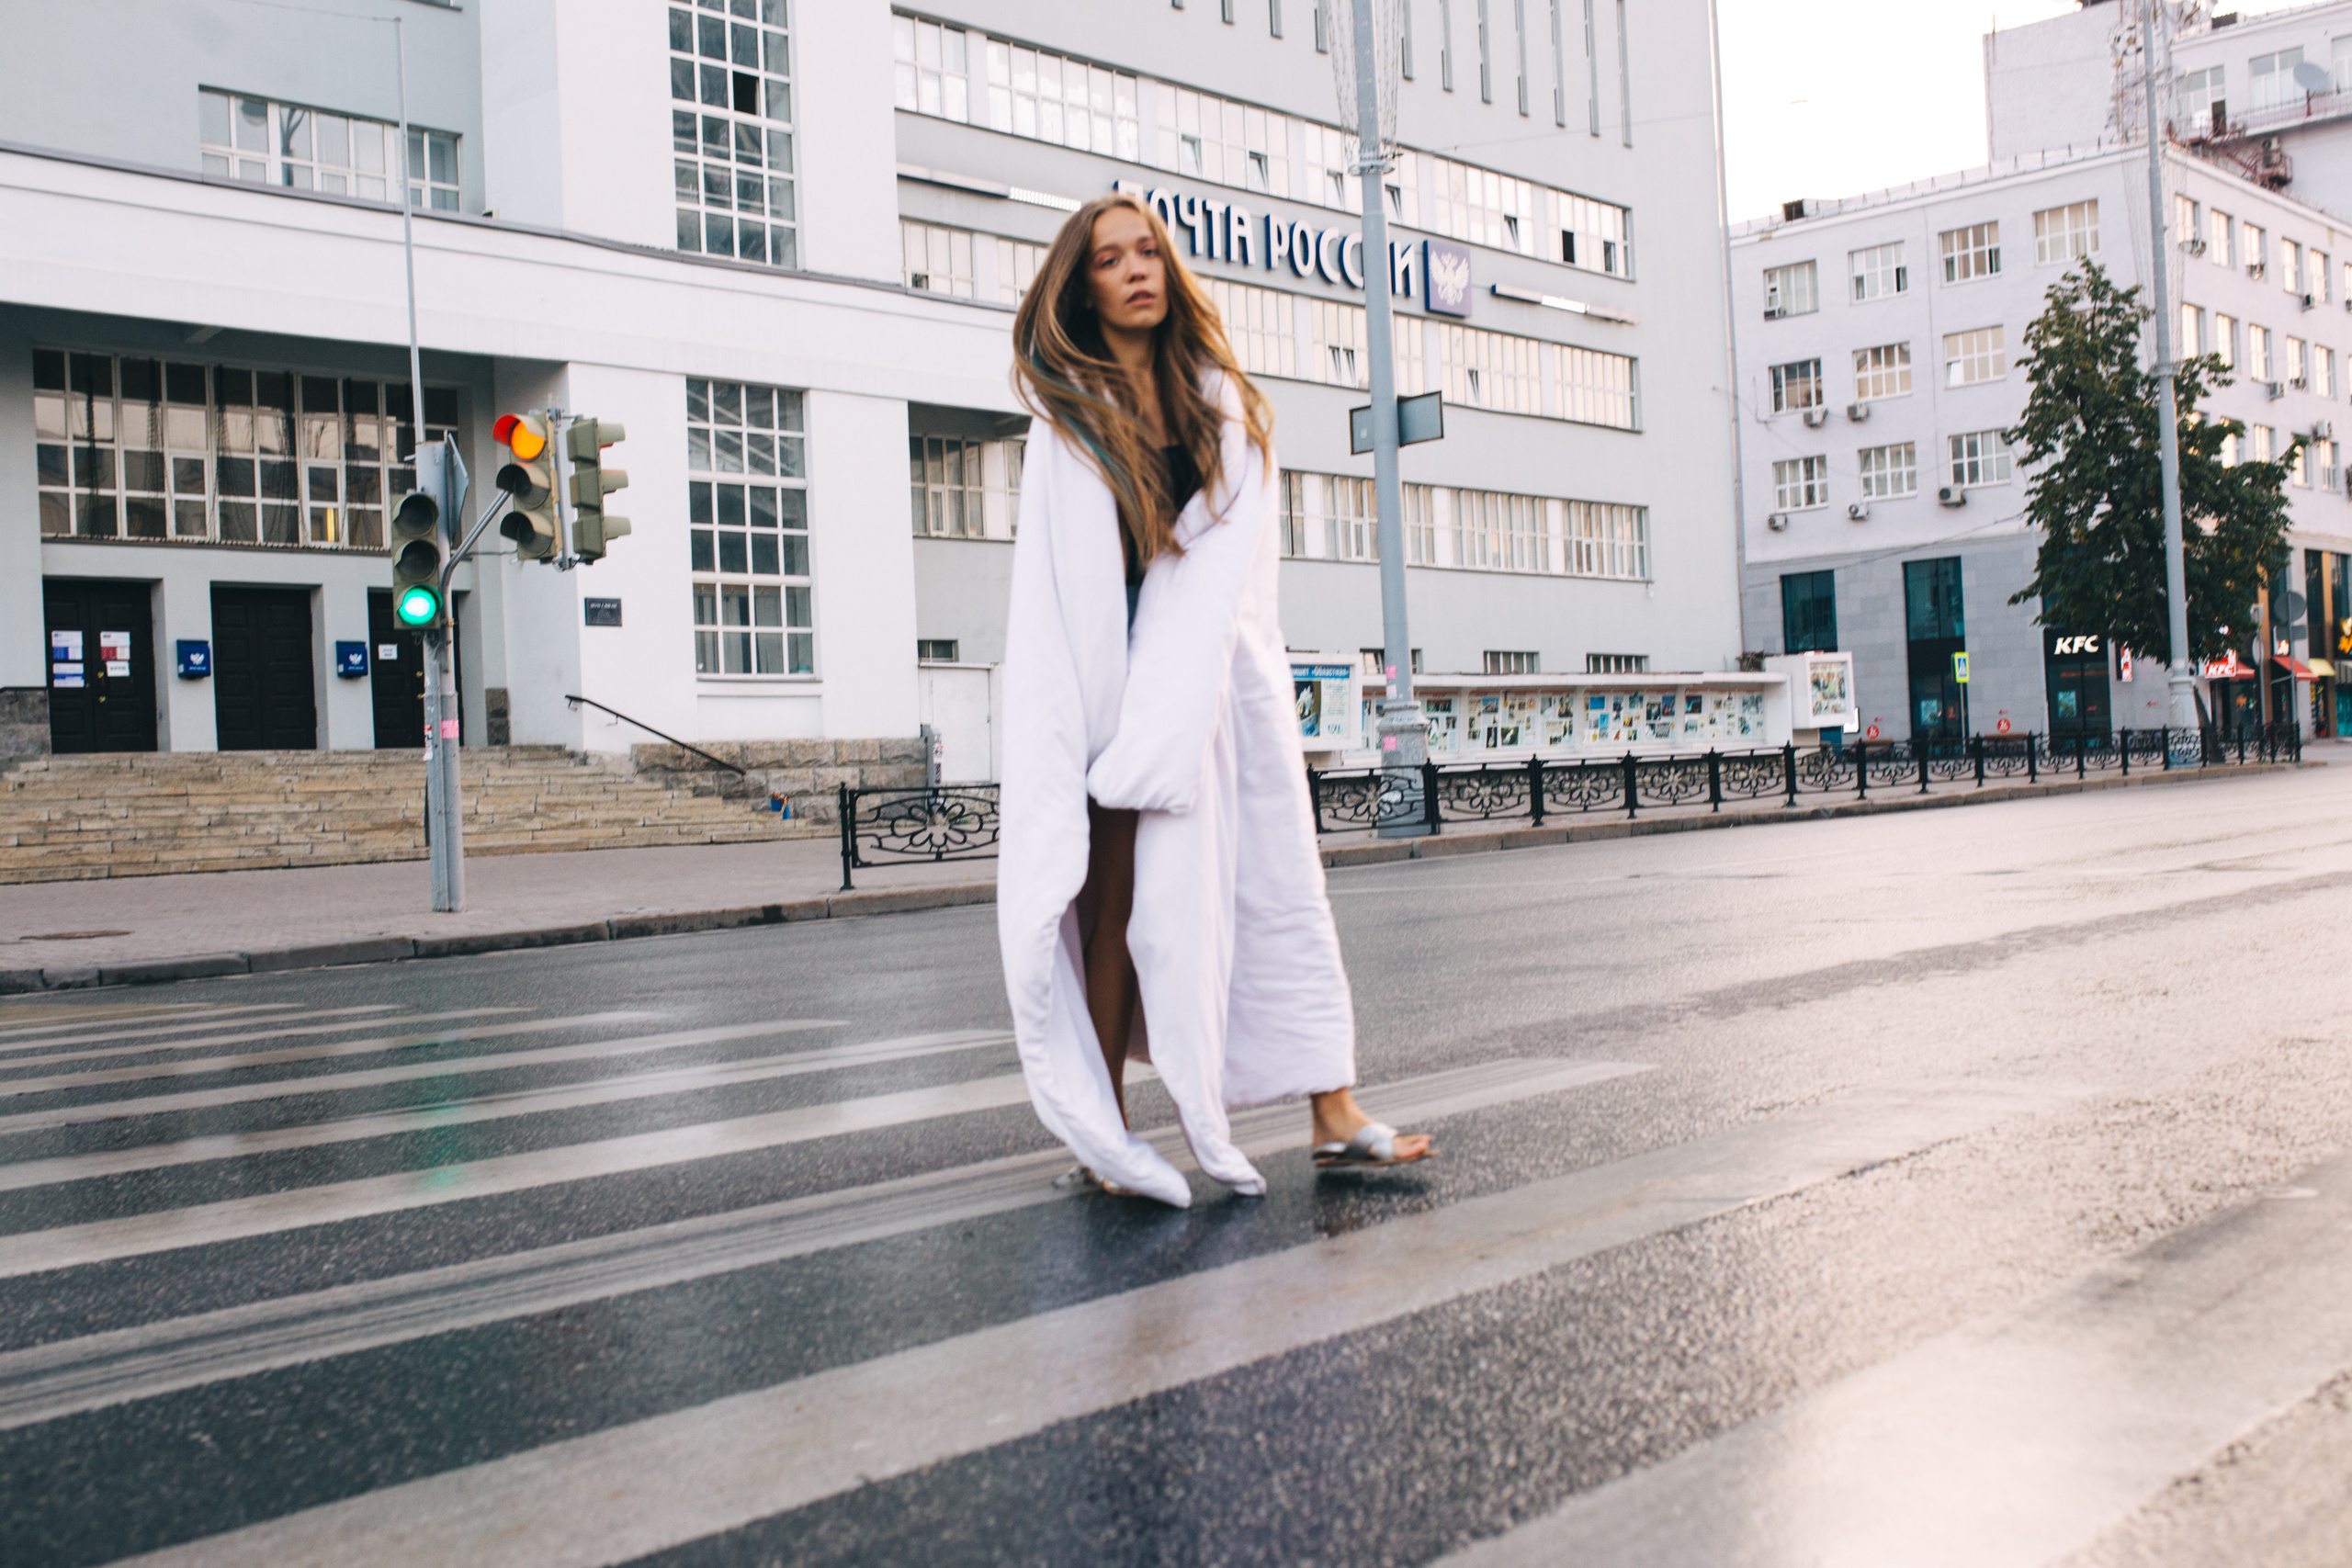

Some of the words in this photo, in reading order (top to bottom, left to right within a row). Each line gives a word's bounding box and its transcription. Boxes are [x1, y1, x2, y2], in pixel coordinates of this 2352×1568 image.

[1265, 213, 1417, 297] РОССИ
[2053, 634, 2099, 655] KFC
[2207, 663, 2235, 676] KFC
